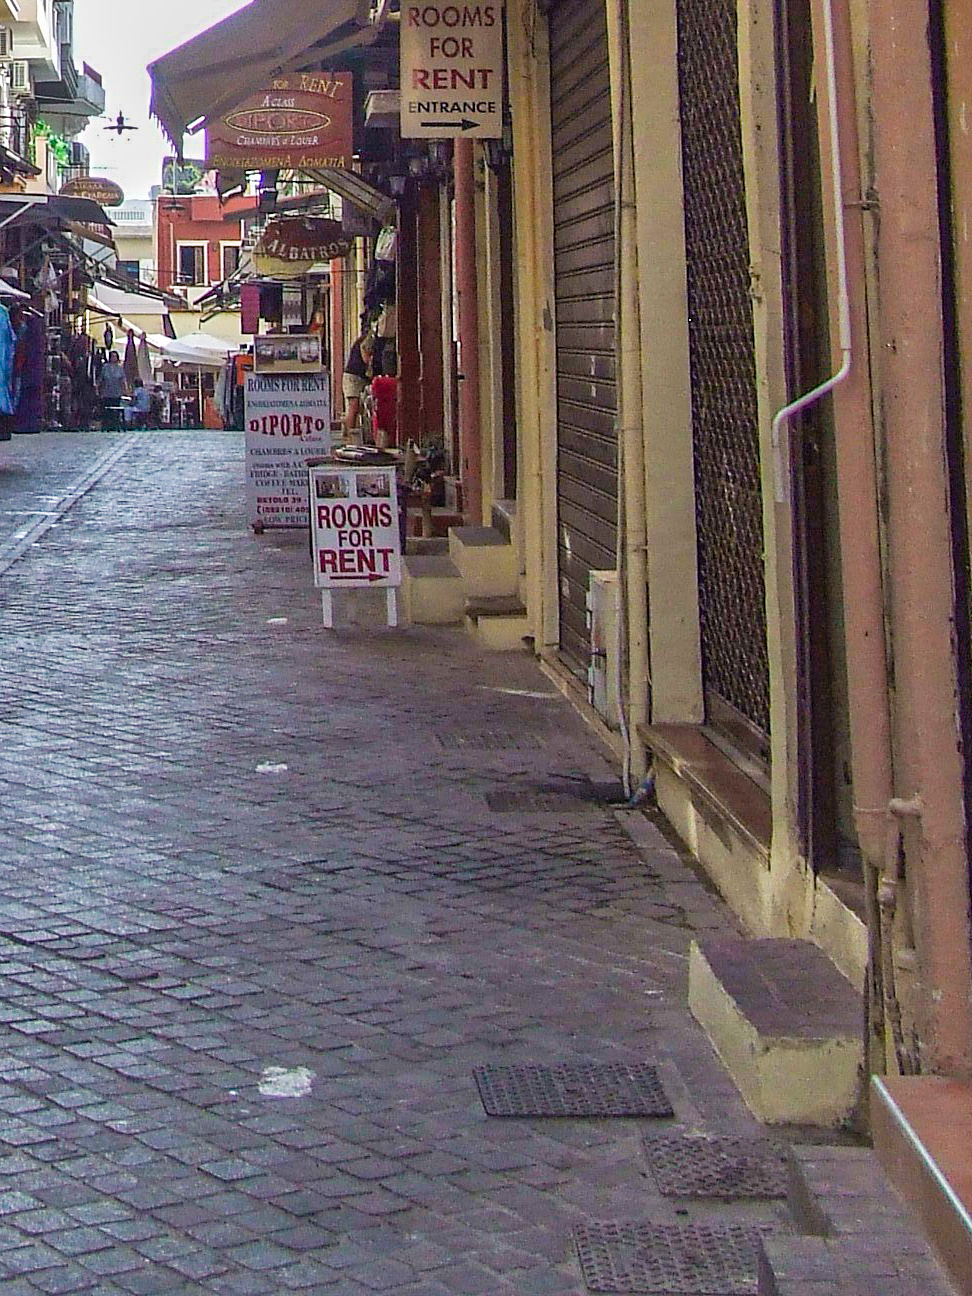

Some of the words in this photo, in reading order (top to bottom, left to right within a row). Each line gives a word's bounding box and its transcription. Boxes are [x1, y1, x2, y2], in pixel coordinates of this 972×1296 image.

[409, 6, 495, 27] ROOMS
[430, 37, 474, 58] FOR
[300, 74, 344, 98] RENT
[412, 69, 493, 90] RENT
[409, 102, 496, 113] ENTRANCE
[291, 135, 319, 145] LOUER
[248, 378, 280, 392] ROOMS
[282, 378, 300, 392] FOR
[302, 377, 325, 392] RENT
[250, 413, 325, 436] DIPORTO
[317, 503, 392, 529] ROOMS
[338, 530, 373, 547] FOR
[319, 548, 393, 573] RENT
